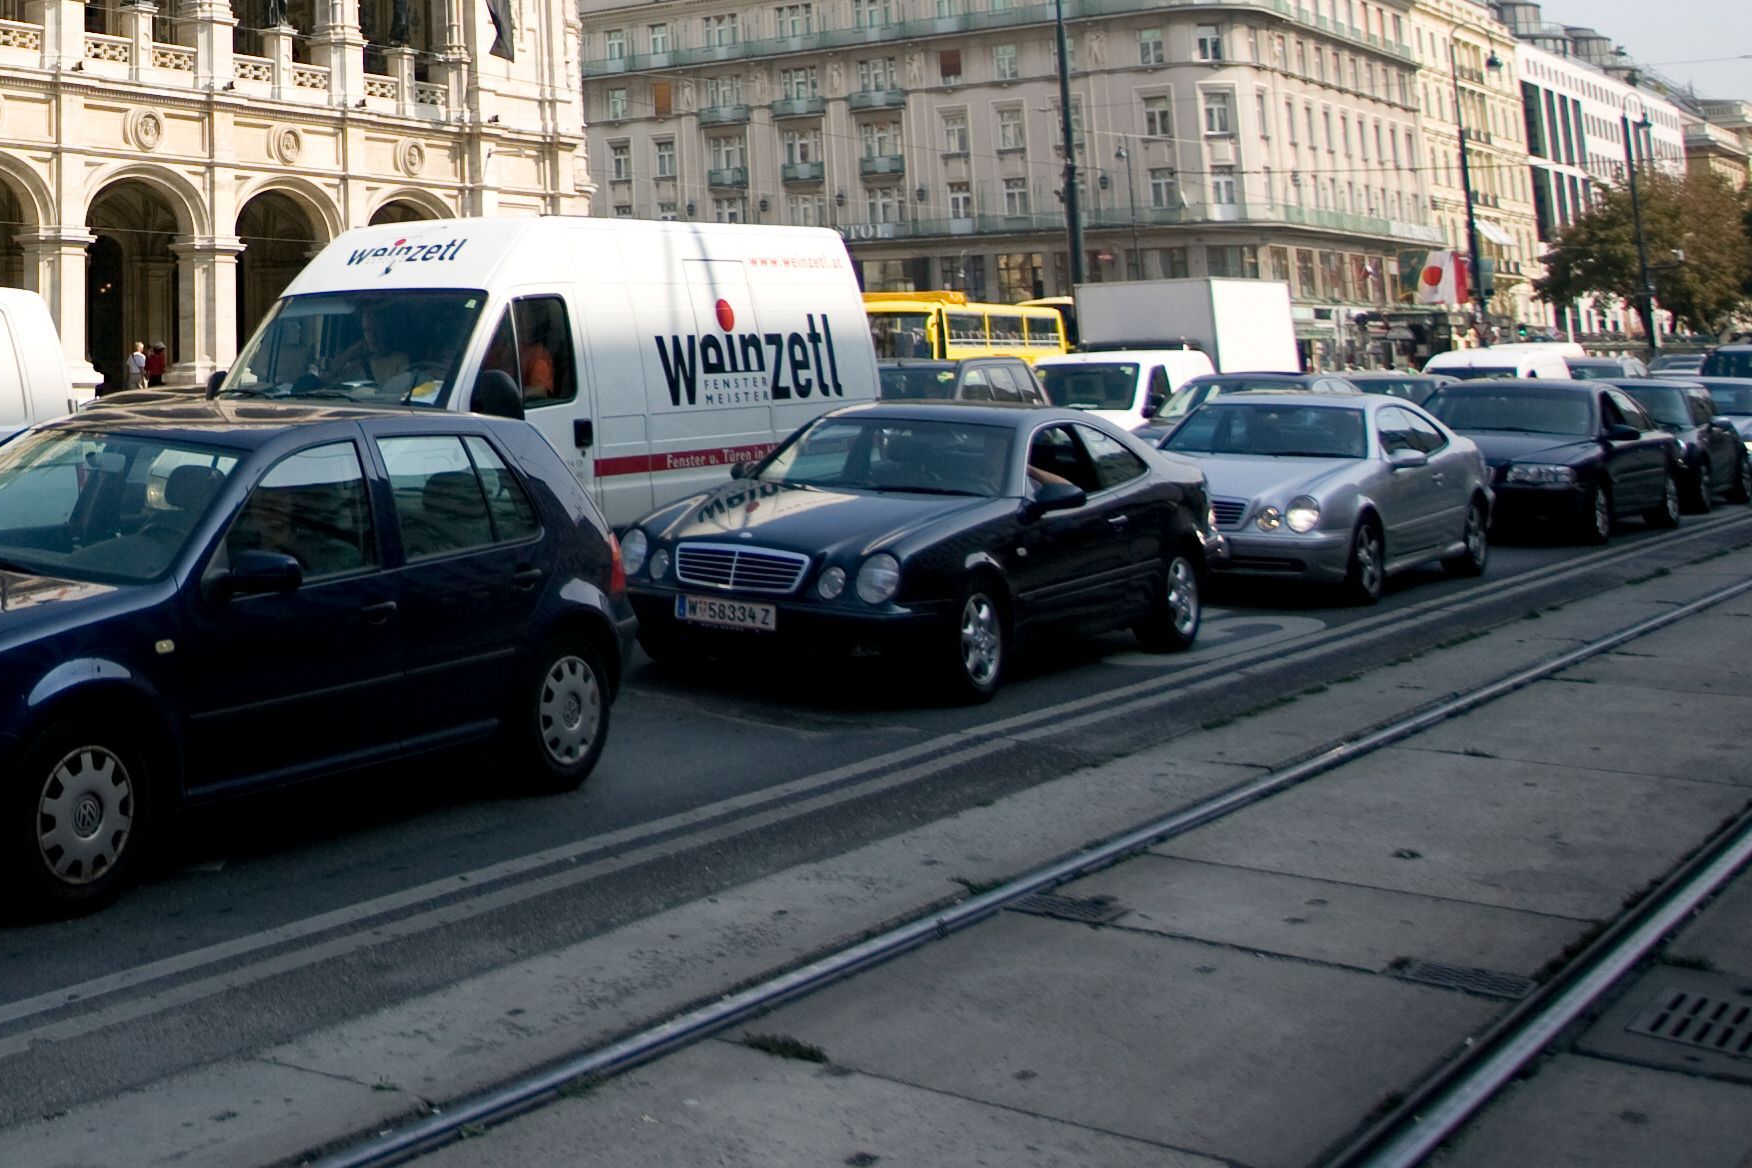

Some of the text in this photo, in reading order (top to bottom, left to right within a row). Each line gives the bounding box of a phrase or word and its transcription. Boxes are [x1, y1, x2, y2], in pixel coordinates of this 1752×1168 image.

[835, 224, 890, 240] STOL
[347, 238, 468, 266] weinzetl
[748, 255, 843, 269] www.weinzetl.at
[655, 299, 844, 406] weinzetl
[704, 376, 768, 389] FENSTER
[705, 391, 769, 404] MEISTER
[666, 450, 706, 469] Fenster
[709, 455, 719, 466] u.
[723, 447, 752, 463] Türen
[754, 447, 764, 461] in
